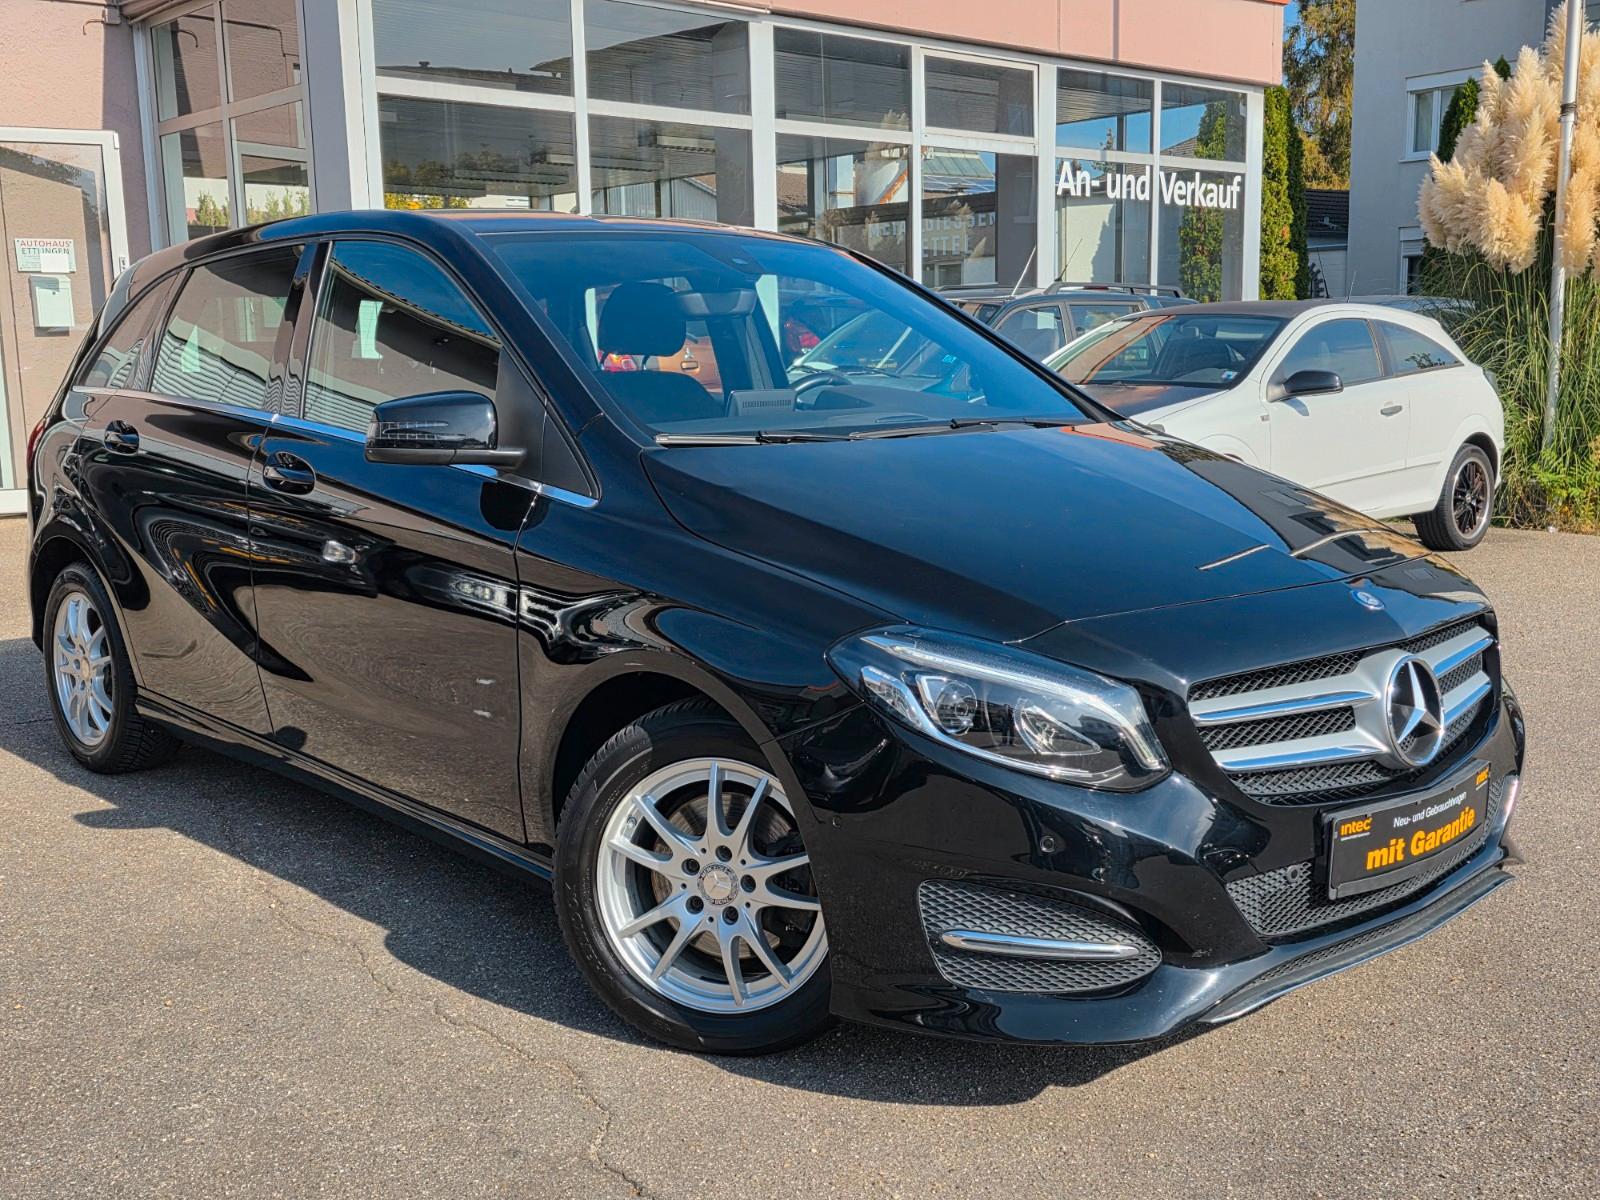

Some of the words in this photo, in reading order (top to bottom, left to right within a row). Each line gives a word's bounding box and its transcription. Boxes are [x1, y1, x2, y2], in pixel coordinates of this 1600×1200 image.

[1056, 161, 1100, 197] An-
[1106, 165, 1150, 200] und
[1159, 171, 1242, 209] Verkauf
[20, 240, 70, 248] AUTOHAUS
[1393, 816, 1411, 828] Neu-
[1412, 809, 1426, 822] und
[1366, 838, 1406, 870] mit
[1410, 806, 1476, 856] Garantie
